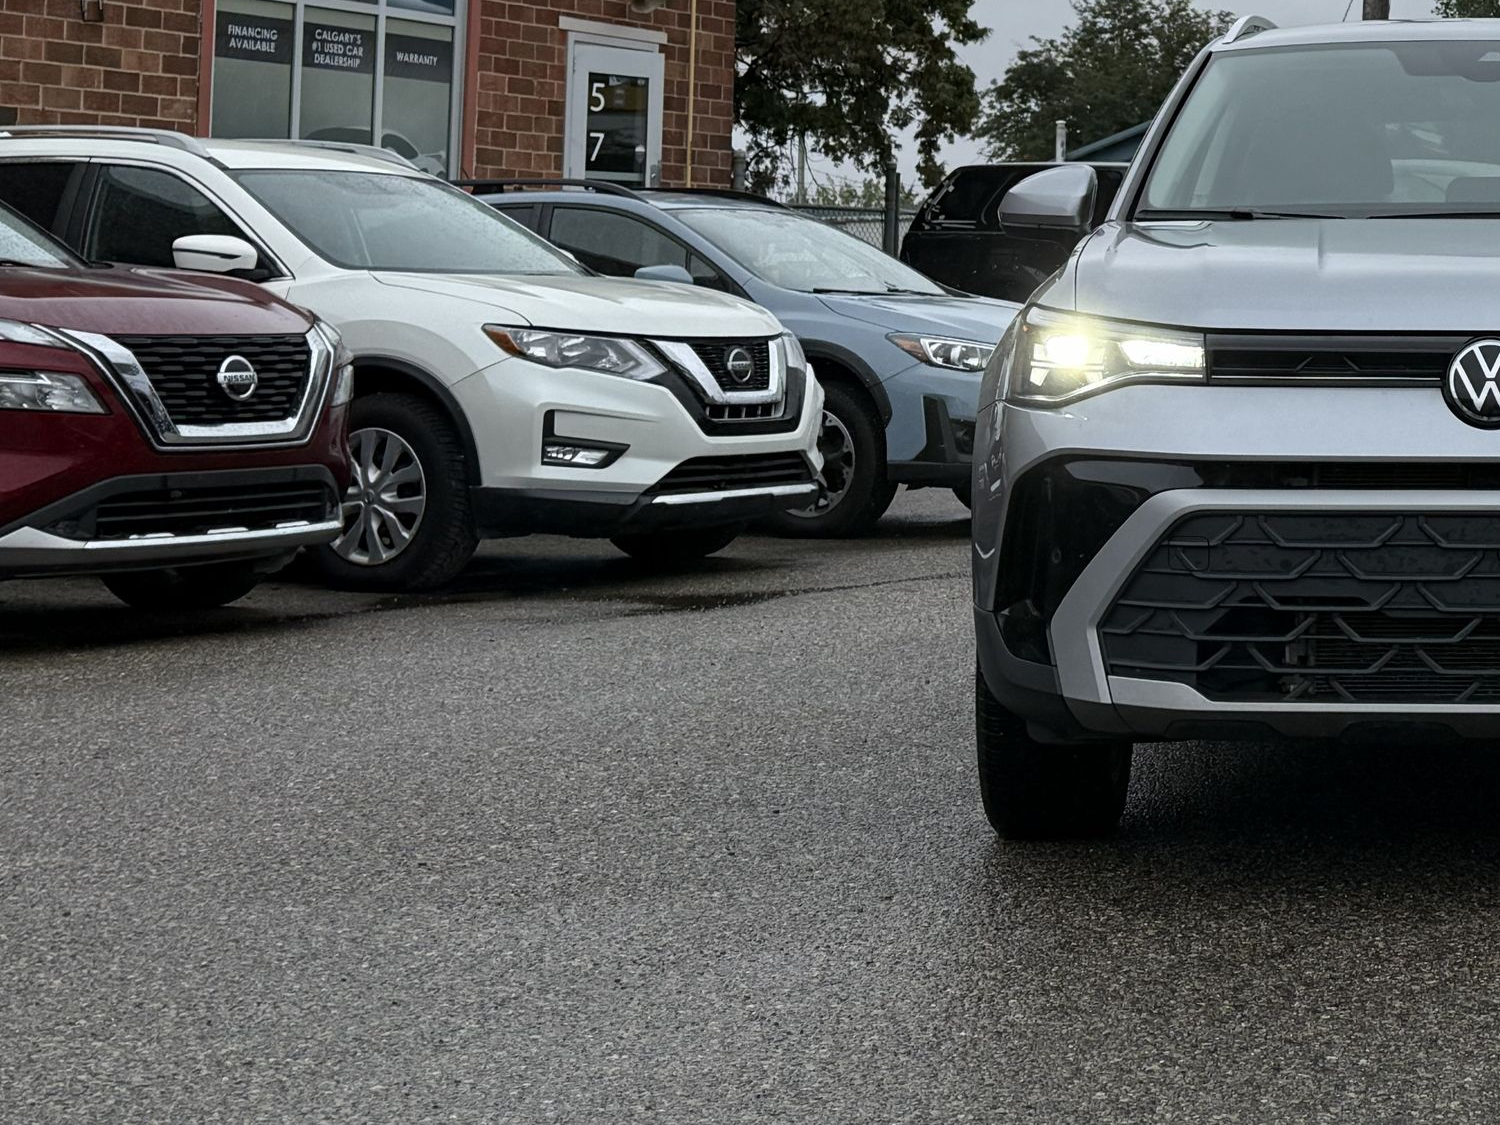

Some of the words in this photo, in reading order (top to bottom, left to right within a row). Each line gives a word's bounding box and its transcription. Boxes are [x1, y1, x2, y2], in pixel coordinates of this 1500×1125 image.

[227, 24, 278, 40] FINANCING
[314, 29, 362, 44] CALGARY'S
[229, 37, 276, 53] AVAILABLE
[312, 42, 322, 52] #1
[324, 44, 344, 55] USED
[346, 46, 363, 57] CAR
[314, 53, 361, 68] DEALERSHIP
[396, 51, 438, 66] WARRANTY
[590, 82, 605, 112] 5
[589, 132, 605, 162] 7
[223, 373, 256, 383] NISSAN
